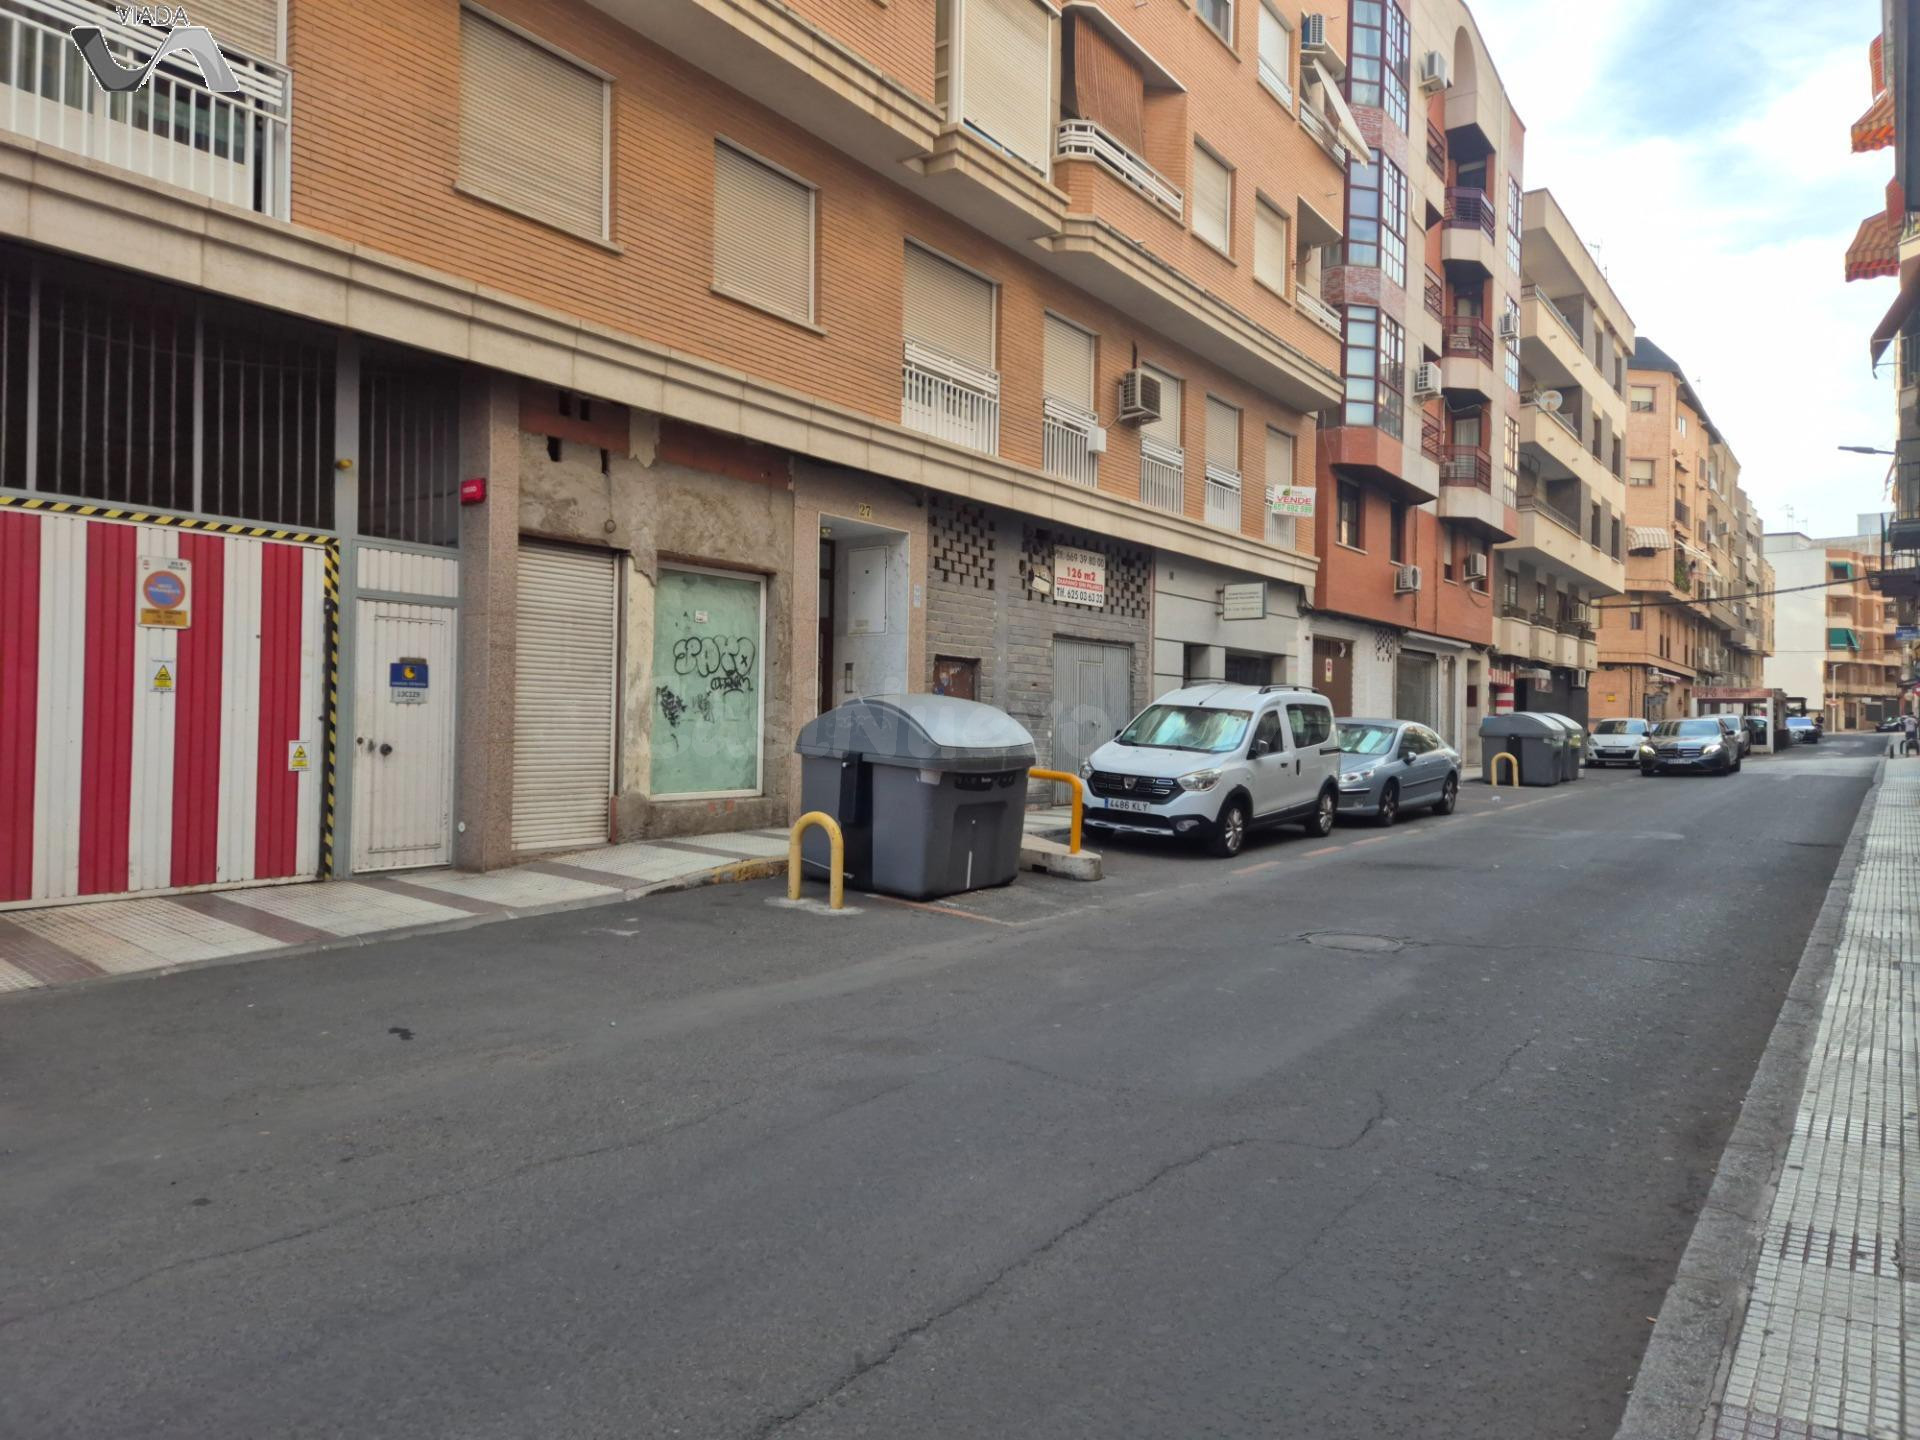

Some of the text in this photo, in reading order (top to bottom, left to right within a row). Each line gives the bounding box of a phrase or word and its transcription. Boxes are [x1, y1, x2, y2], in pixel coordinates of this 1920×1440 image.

[1277, 495, 1312, 505] VENDE
[859, 503, 871, 517] 27
[1080, 553, 1088, 564] 39
[1067, 566, 1096, 582] 126 m2
[1067, 590, 1079, 600] 625
[1096, 594, 1104, 604] 32
[1110, 800, 1148, 811] 4486 KLY
